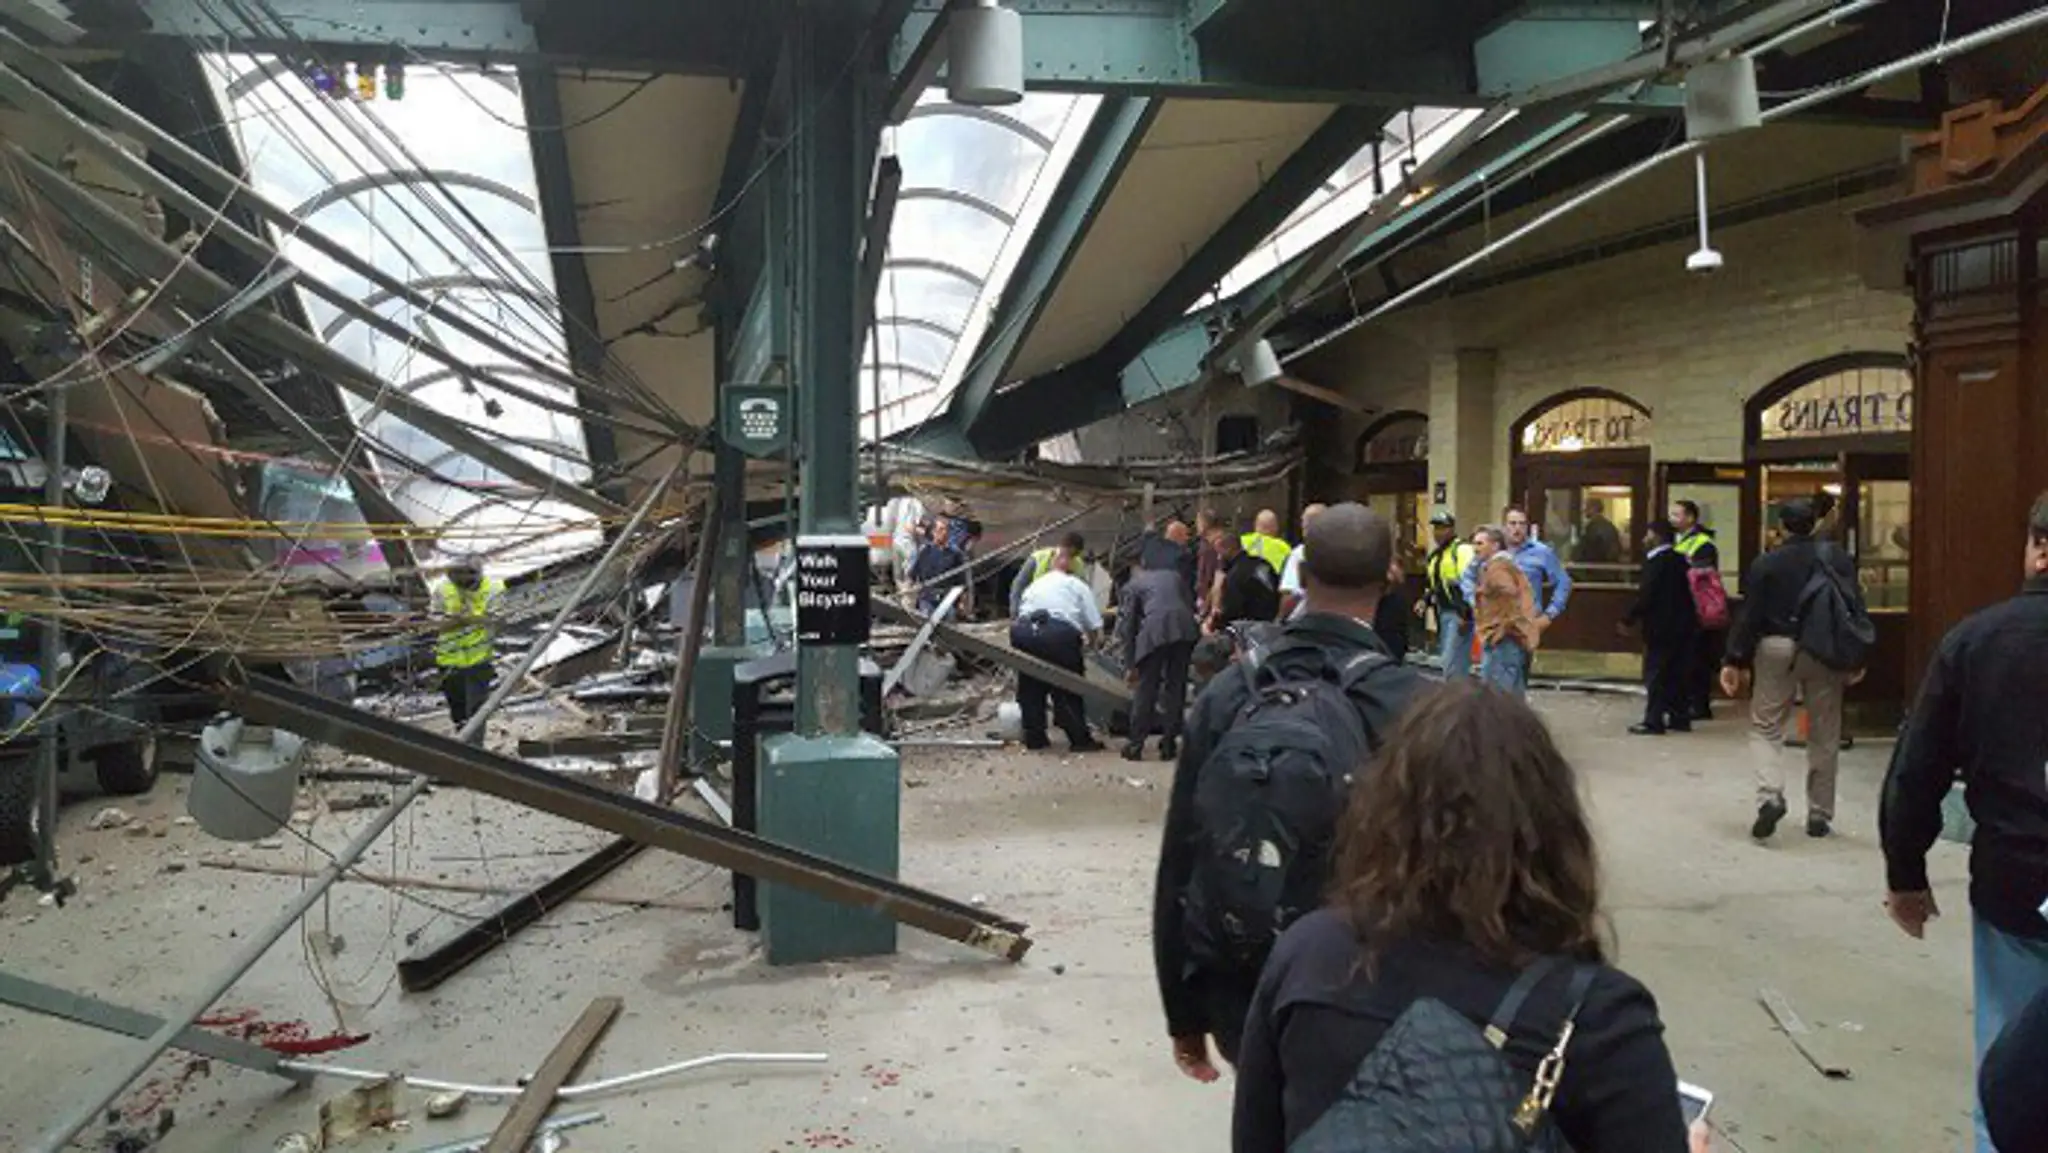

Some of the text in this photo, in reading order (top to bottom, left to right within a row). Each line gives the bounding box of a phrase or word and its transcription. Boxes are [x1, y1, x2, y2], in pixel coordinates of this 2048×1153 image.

[799, 553, 838, 568] Walk
[800, 573, 837, 587] Your
[799, 591, 856, 610] Bicycle
